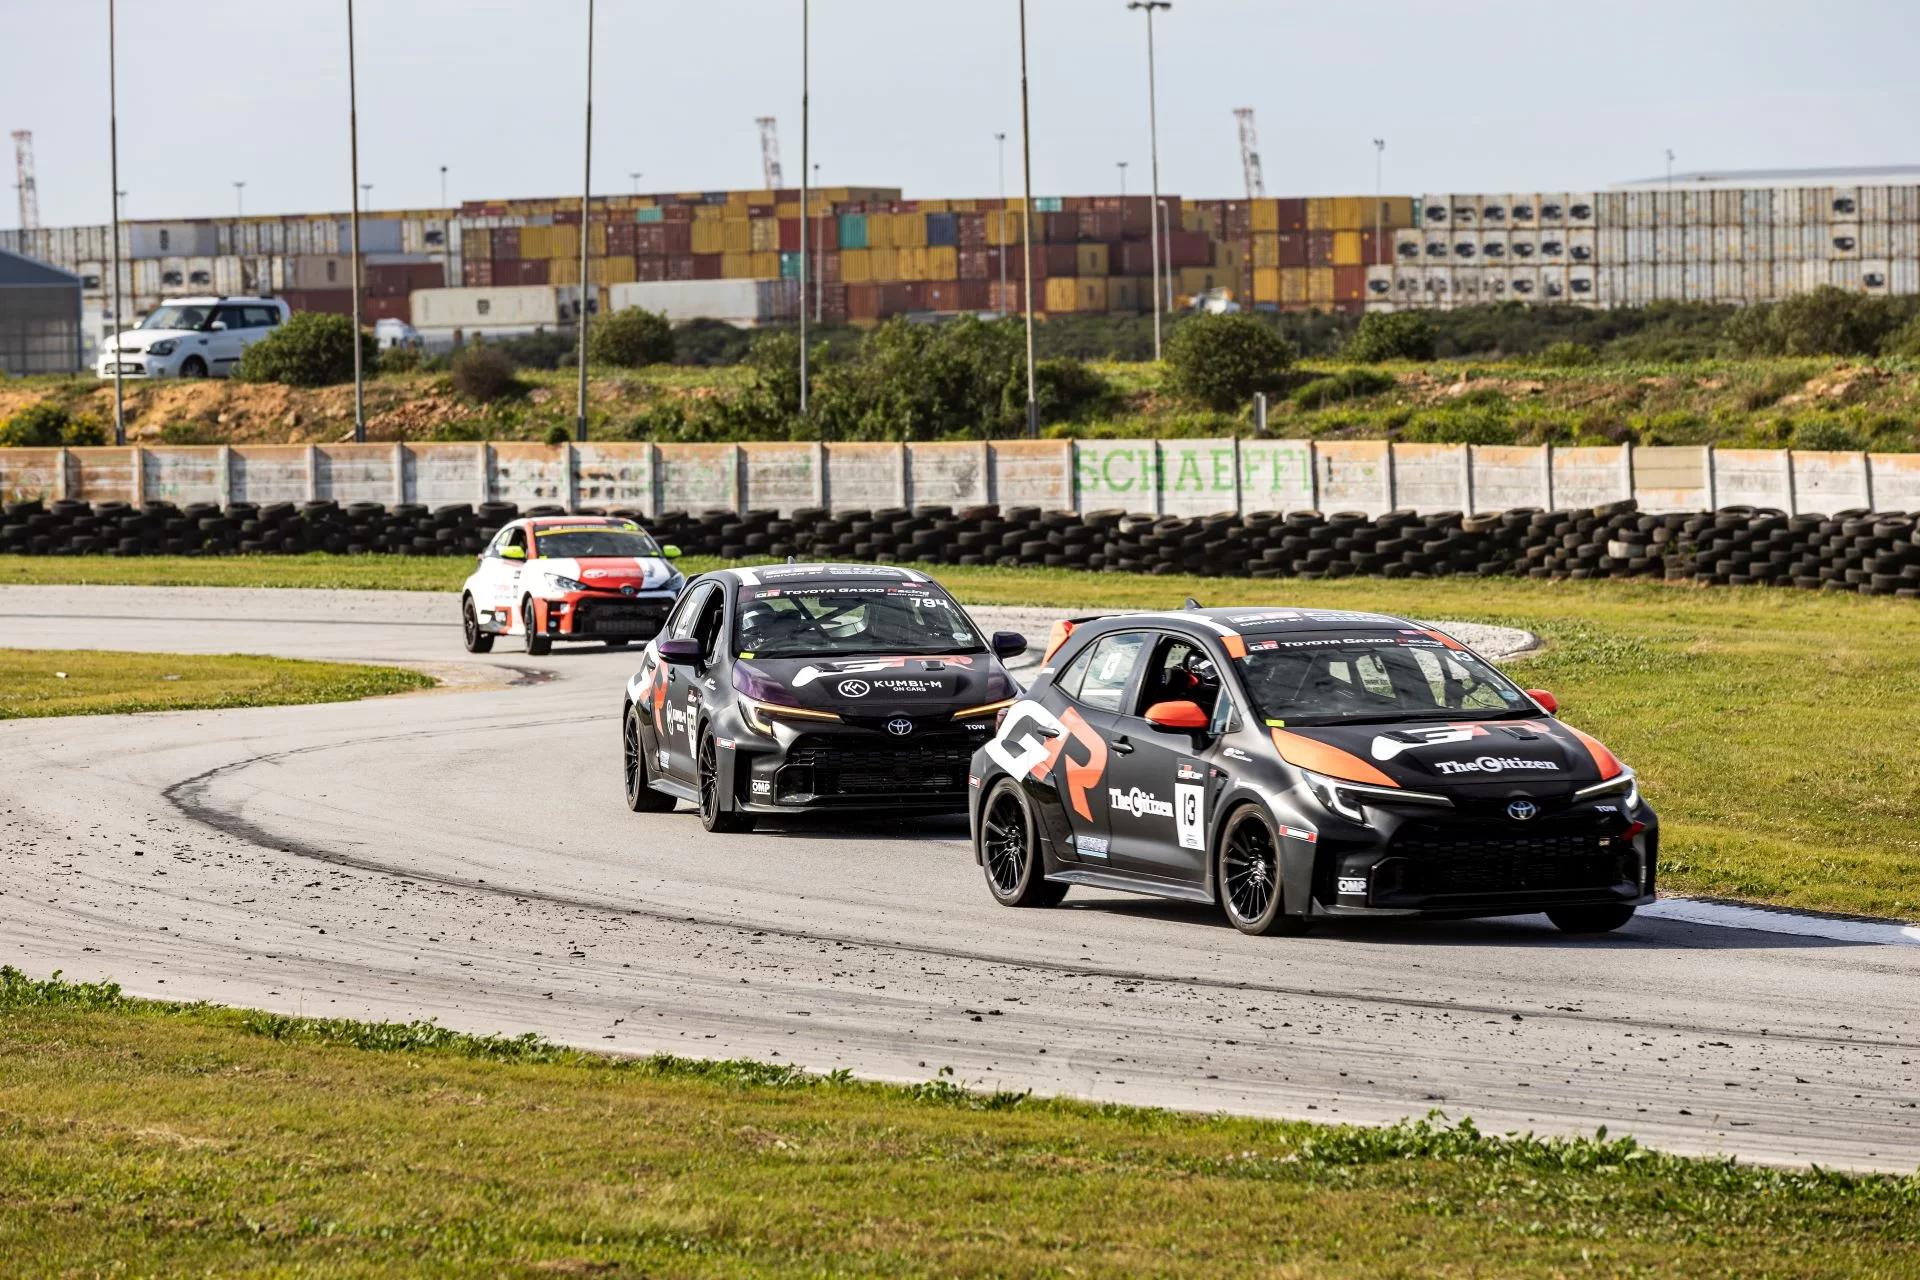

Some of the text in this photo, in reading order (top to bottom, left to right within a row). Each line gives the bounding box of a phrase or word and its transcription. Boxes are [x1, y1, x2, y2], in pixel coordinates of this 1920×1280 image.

[784, 588, 836, 596] TOYOTA
[910, 597, 949, 609] 794
[1248, 642, 1279, 652] GR
[1280, 639, 1341, 647] TOYOTA
[873, 679, 943, 689] KUMBI-M
[984, 699, 1108, 824] GR
[752, 782, 770, 793] OMP
[1183, 793, 1196, 827] 13
[1594, 805, 1618, 813] TOW
[1338, 880, 1367, 892] OMP
